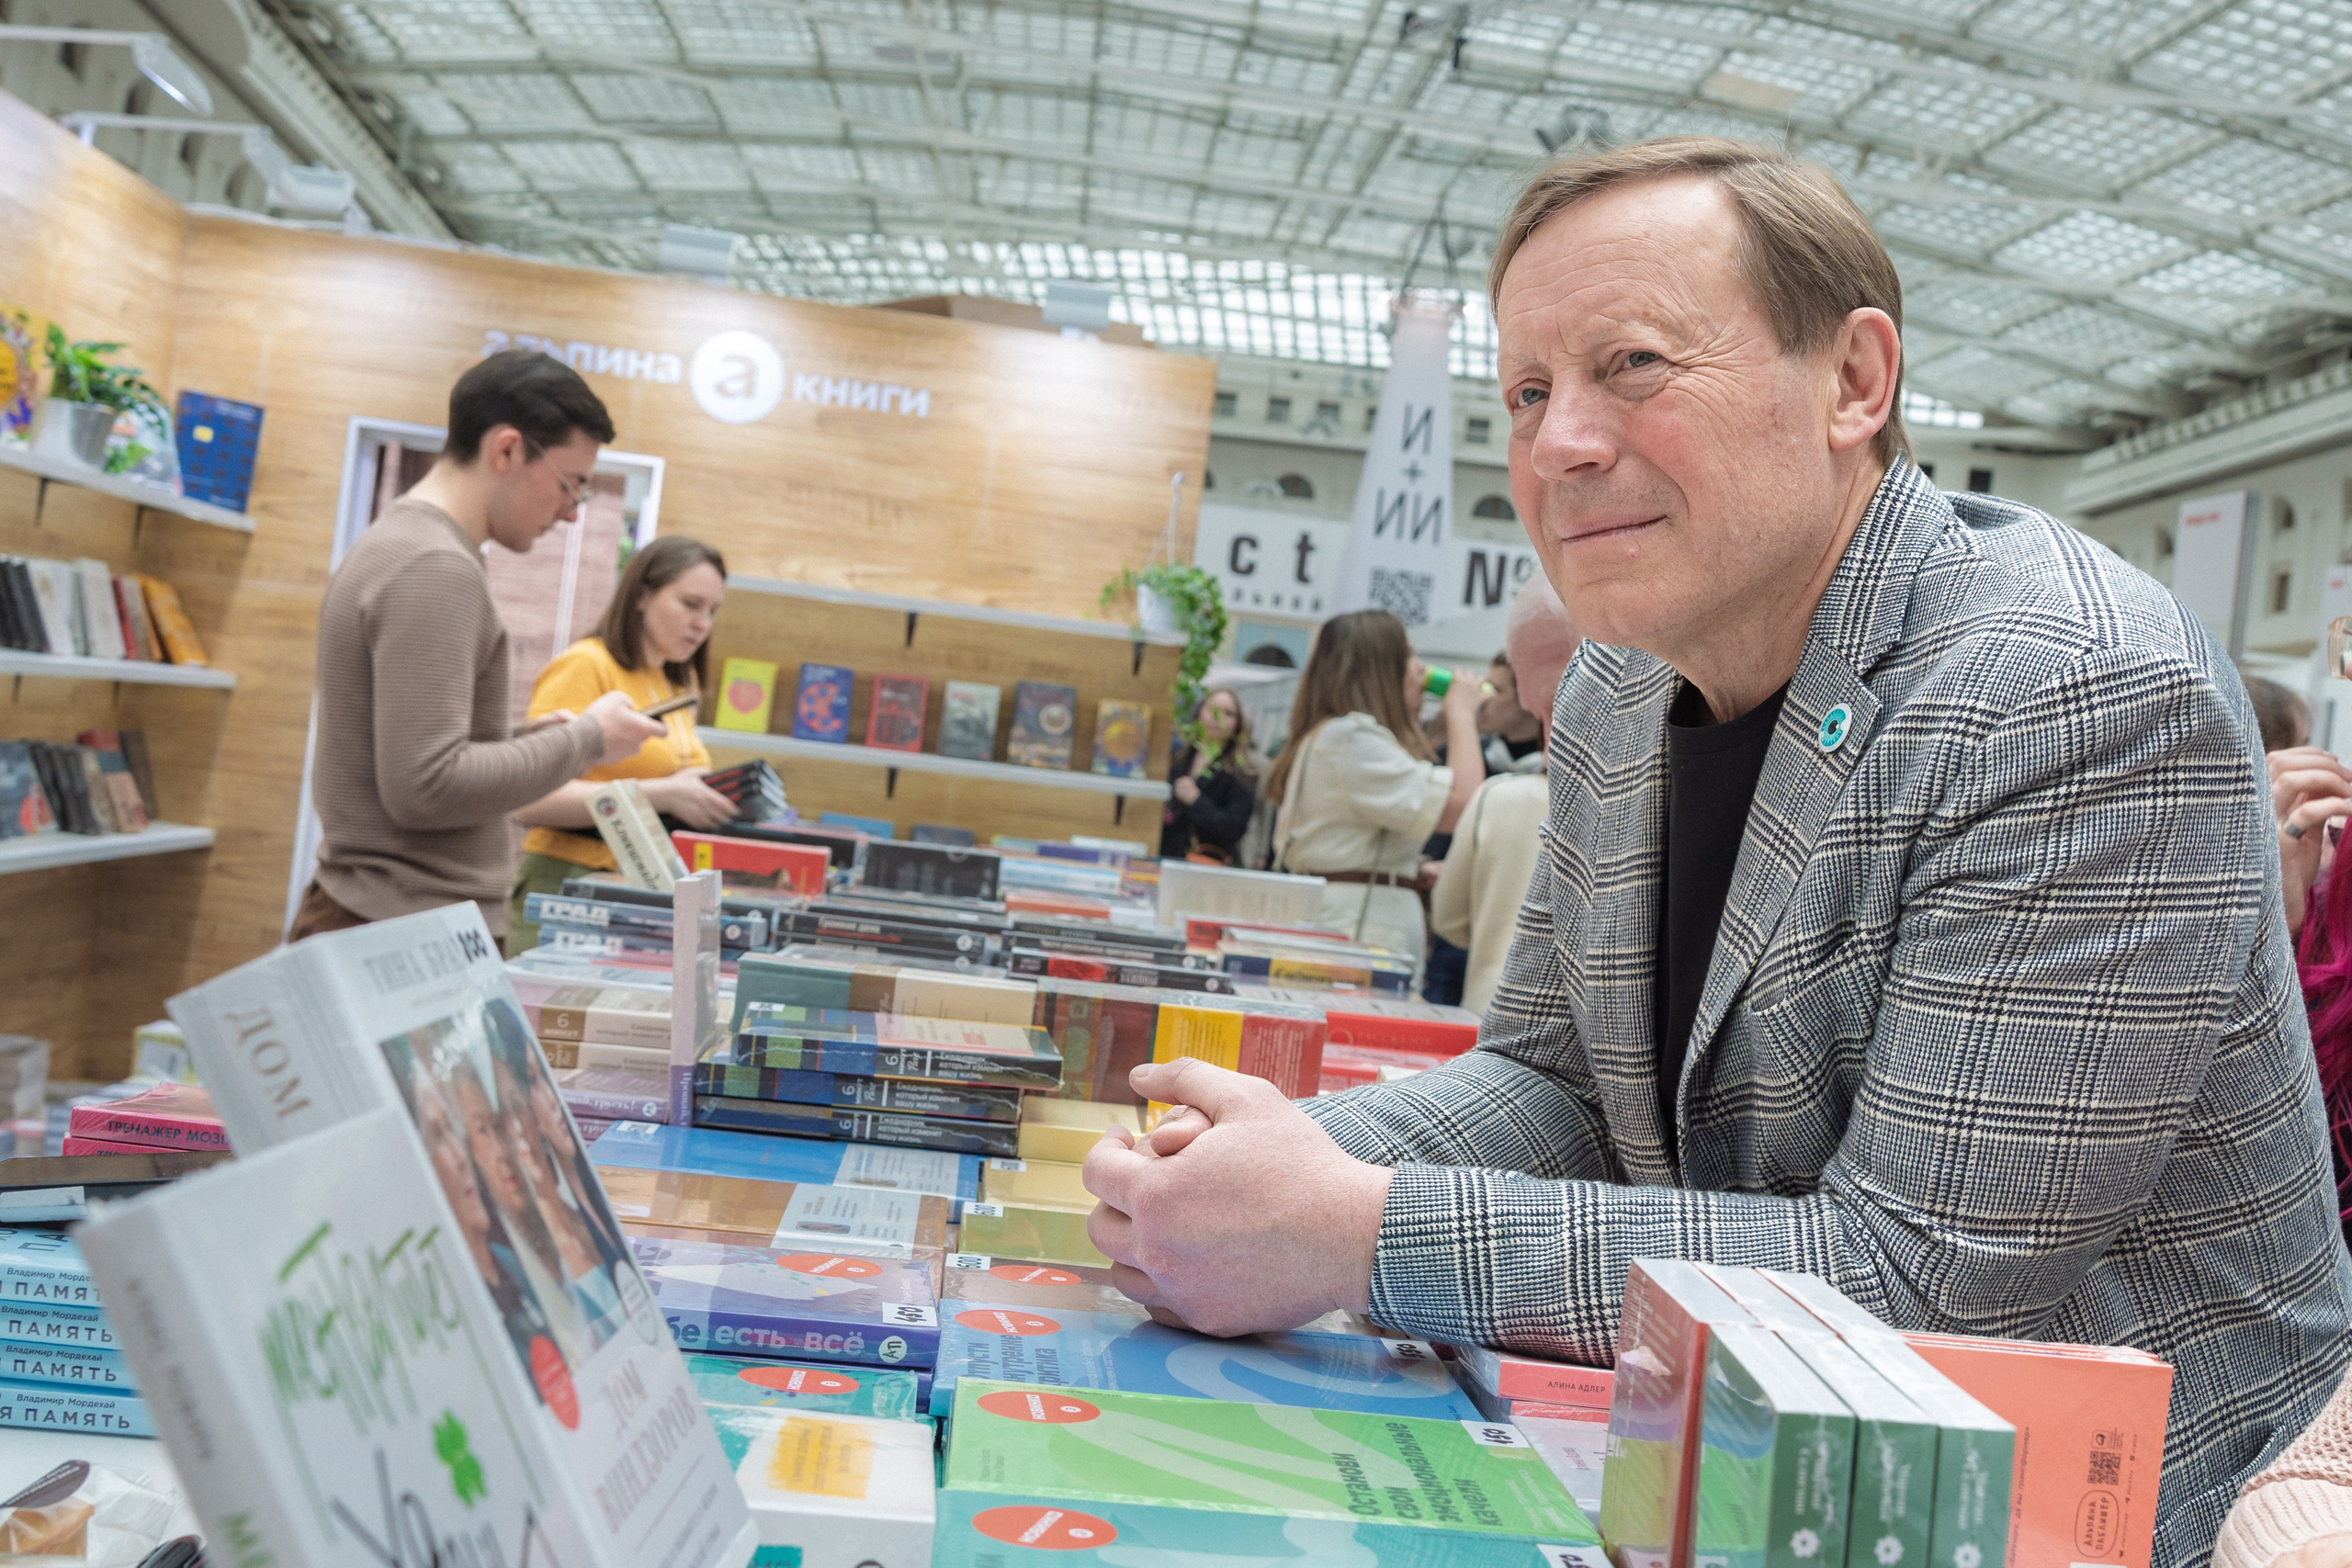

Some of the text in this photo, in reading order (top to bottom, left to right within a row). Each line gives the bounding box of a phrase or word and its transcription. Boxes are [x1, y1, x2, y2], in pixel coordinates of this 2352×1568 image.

[793, 371, 931, 419] книги
[107, 1120, 182, 1140] ТРЕНАЖЕР
[6, 1267, 55, 1280] Владимир
[1, 1305, 99, 1323] Владимир Мордехай
[8, 1319, 113, 1343] ПАМЯТЬ
[714, 1325, 786, 1348] есть
[803, 1330, 865, 1355] всё
[6, 1345, 103, 1362] Владимир Мордехай
[13, 1359, 118, 1382] ПАМЯТЬ
[1547, 1381, 1606, 1393] АЛИНА АДЛЕР
[17, 1393, 116, 1410] Владимир Мордехай
[24, 1407, 130, 1429] ПАМЯТЬ
[1331, 1451, 1383, 1517] Останови
[1385, 1422, 1464, 1524] эмоциональные
[1384, 1485, 1423, 1520] свои
[1453, 1478, 1504, 1527] качели
[2084, 1500, 2098, 1547] АЛЬПИНА
[2096, 1496, 2110, 1551] ПАБЛИШЕР
